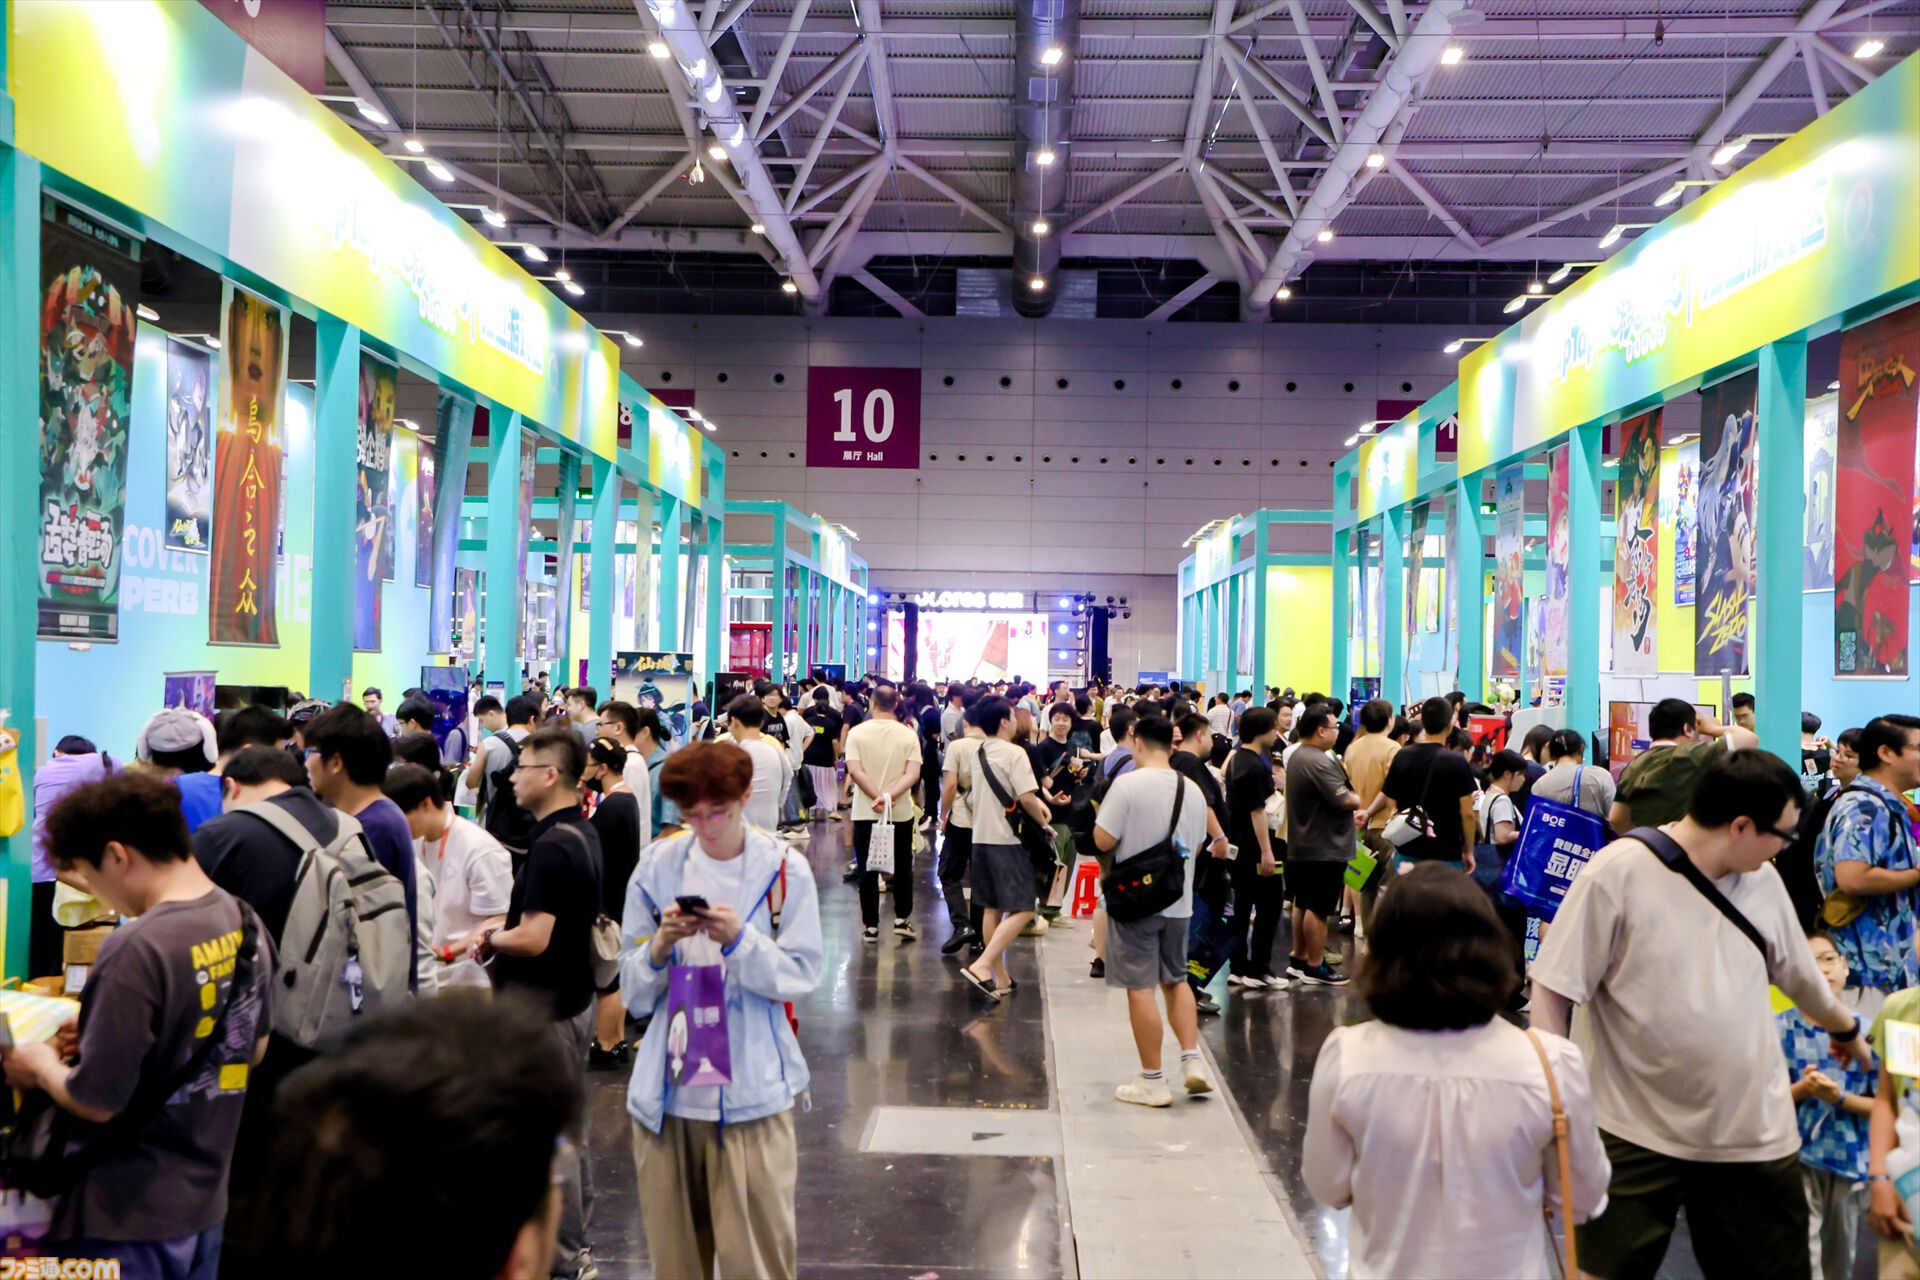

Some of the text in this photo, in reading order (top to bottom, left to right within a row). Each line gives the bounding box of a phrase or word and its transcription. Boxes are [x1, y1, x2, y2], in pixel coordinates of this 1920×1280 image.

[833, 388, 895, 443] 10
[843, 450, 884, 462] 展厅 Hall
[1541, 813, 1566, 828] BOE
